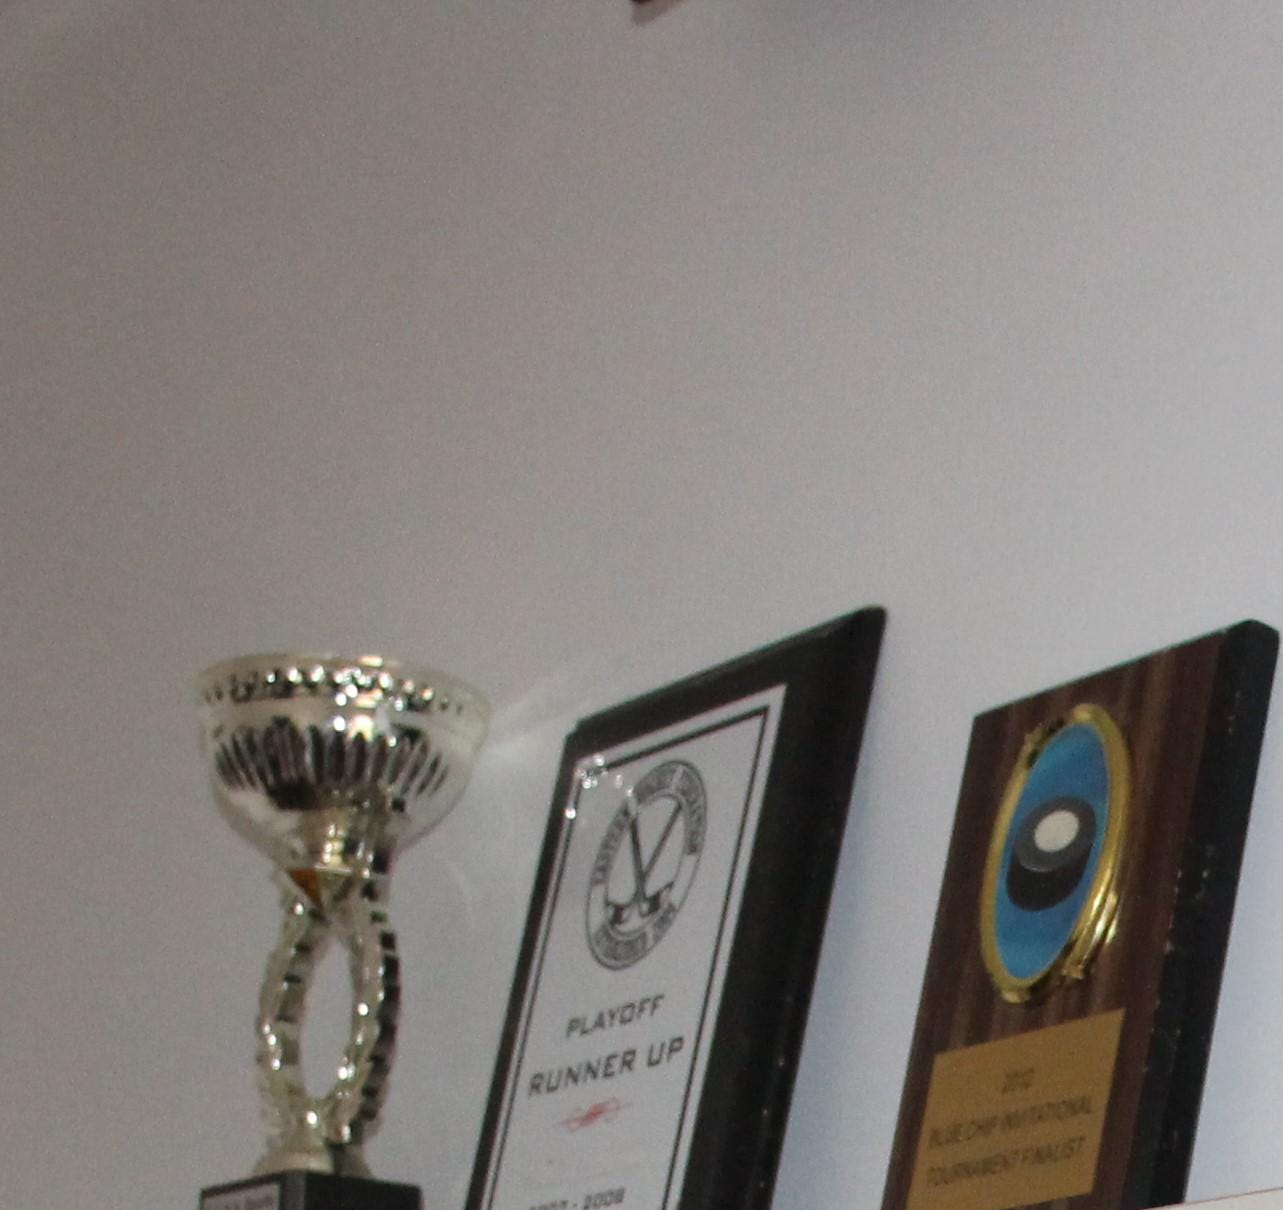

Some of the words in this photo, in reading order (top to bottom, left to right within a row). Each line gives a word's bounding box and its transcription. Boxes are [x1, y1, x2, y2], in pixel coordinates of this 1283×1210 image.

[565, 994, 665, 1039] PLAYOFF
[528, 1048, 638, 1097] RUNNER
[646, 1035, 685, 1068] UP
[928, 1150, 1019, 1186] TOURNAMENT
